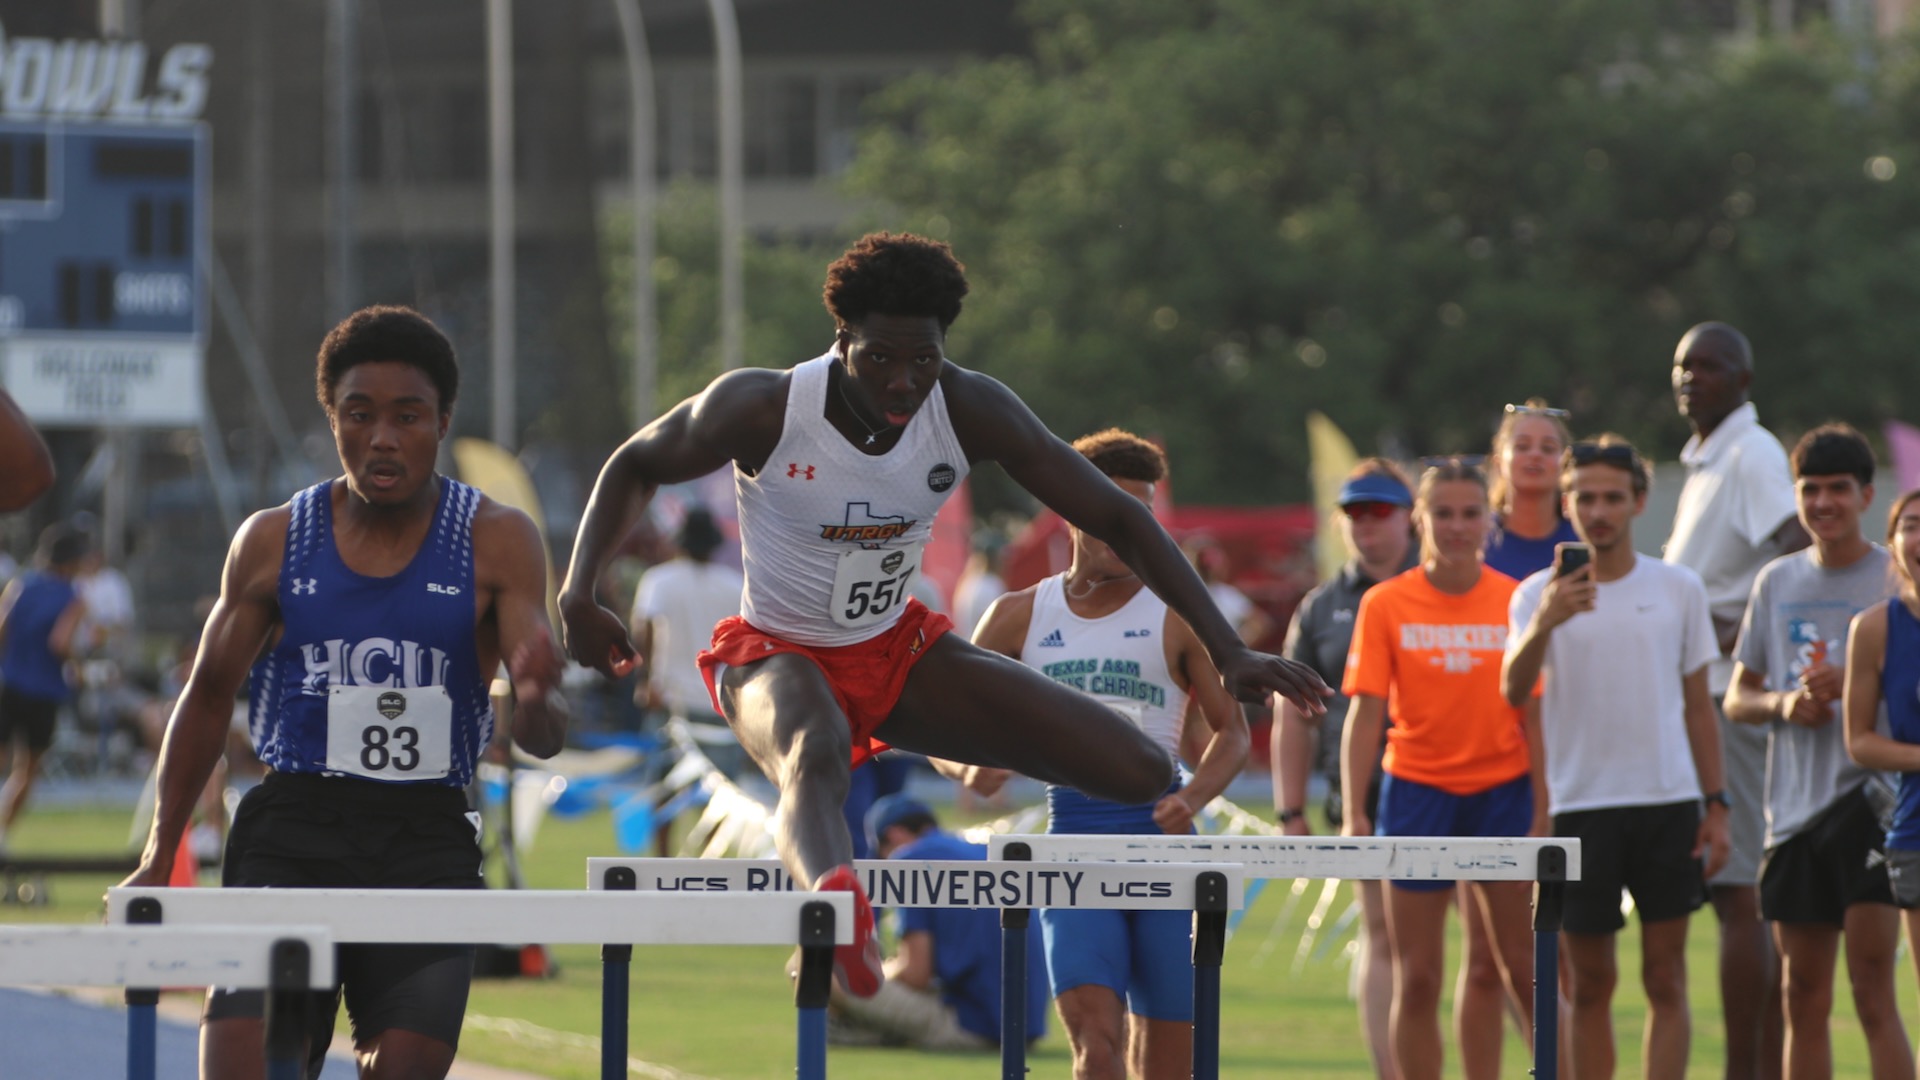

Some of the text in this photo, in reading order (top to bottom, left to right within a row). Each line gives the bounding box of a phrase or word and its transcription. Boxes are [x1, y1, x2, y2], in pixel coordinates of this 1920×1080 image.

[820, 521, 917, 541] UTRGV
[845, 565, 915, 620] 557
[299, 637, 450, 695] HCU
[1042, 658, 1141, 678] TEXAS A&M
[1092, 676, 1166, 708] CHRISTI
[360, 725, 420, 771] 83
[657, 877, 729, 891] UCS
[1101, 881, 1172, 897] UCS
